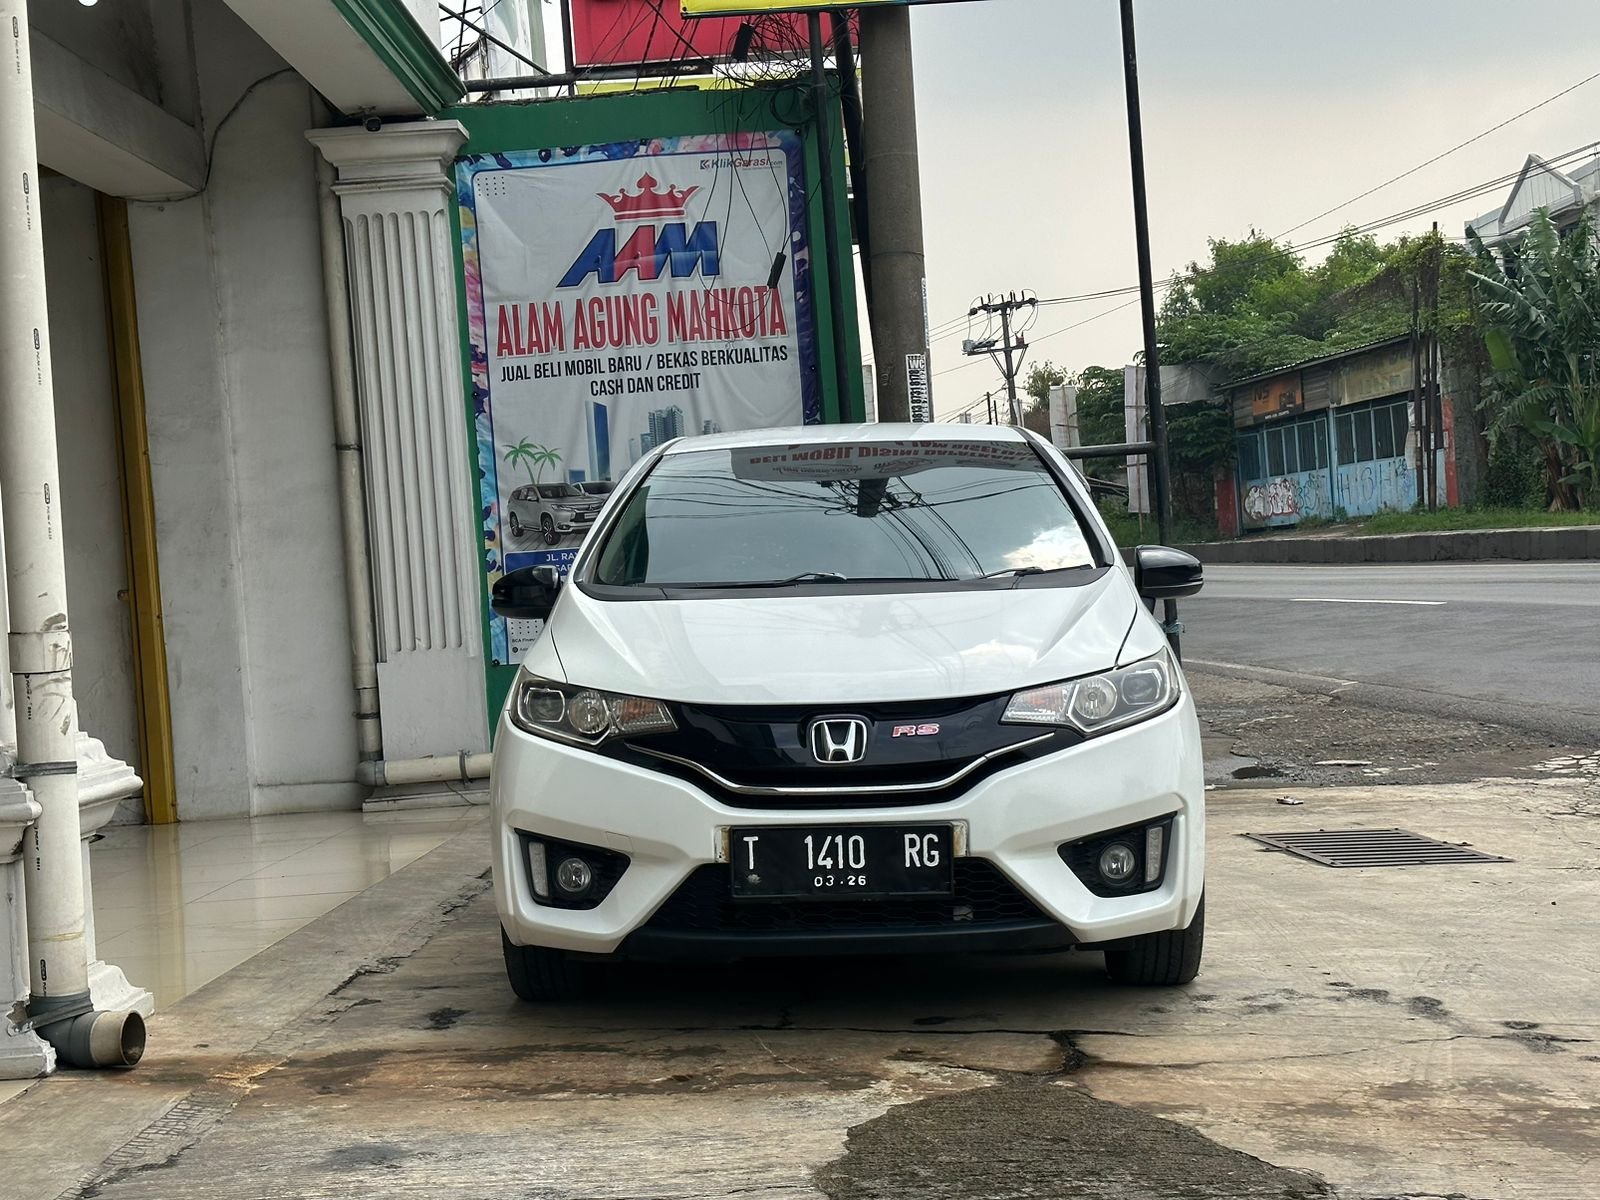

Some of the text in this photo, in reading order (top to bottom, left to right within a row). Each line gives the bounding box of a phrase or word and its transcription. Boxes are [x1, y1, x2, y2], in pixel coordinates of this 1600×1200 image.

[556, 221, 719, 287] AAM
[497, 285, 788, 358] ALAM AGUNG MAHKOTA
[501, 345, 788, 382] JUAL BELI MOBIL BARU / BEKAS BERKUALITAS
[590, 373, 702, 397] CASH DAN CREDIT
[546, 553, 559, 561] JL.
[892, 723, 940, 738] RS
[743, 833, 940, 870] T 1410 RG
